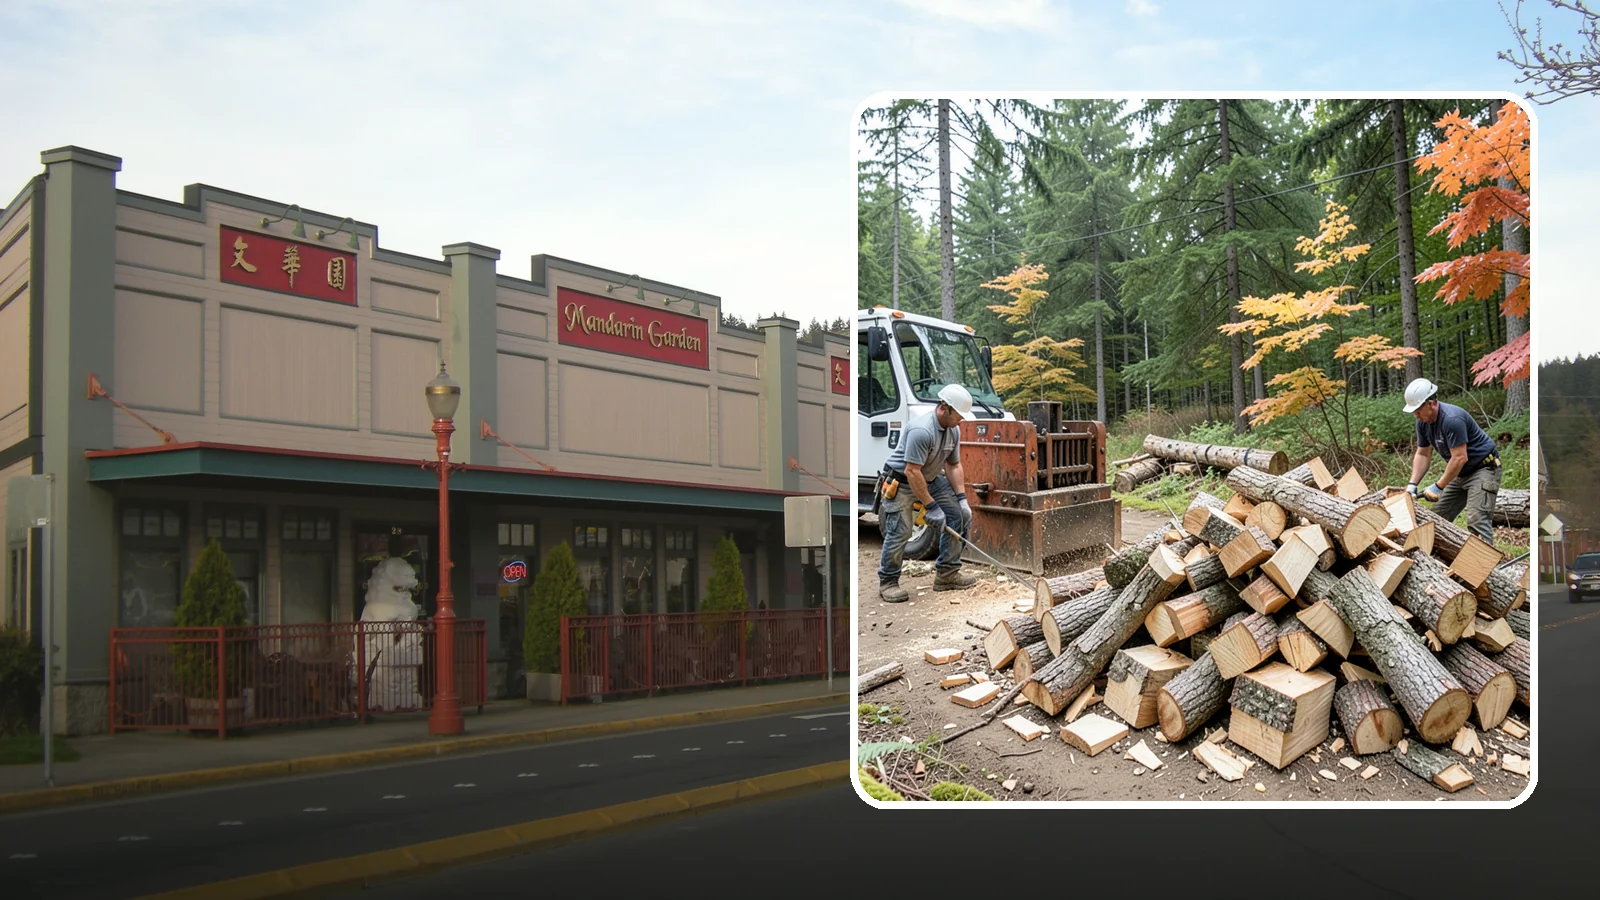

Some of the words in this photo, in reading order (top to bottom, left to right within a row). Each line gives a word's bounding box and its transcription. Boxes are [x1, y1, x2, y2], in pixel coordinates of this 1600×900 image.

[231, 235, 347, 291] 文華園
[564, 302, 645, 341] Mandarin
[648, 320, 701, 352] Garden
[503, 565, 527, 578] OPEN
